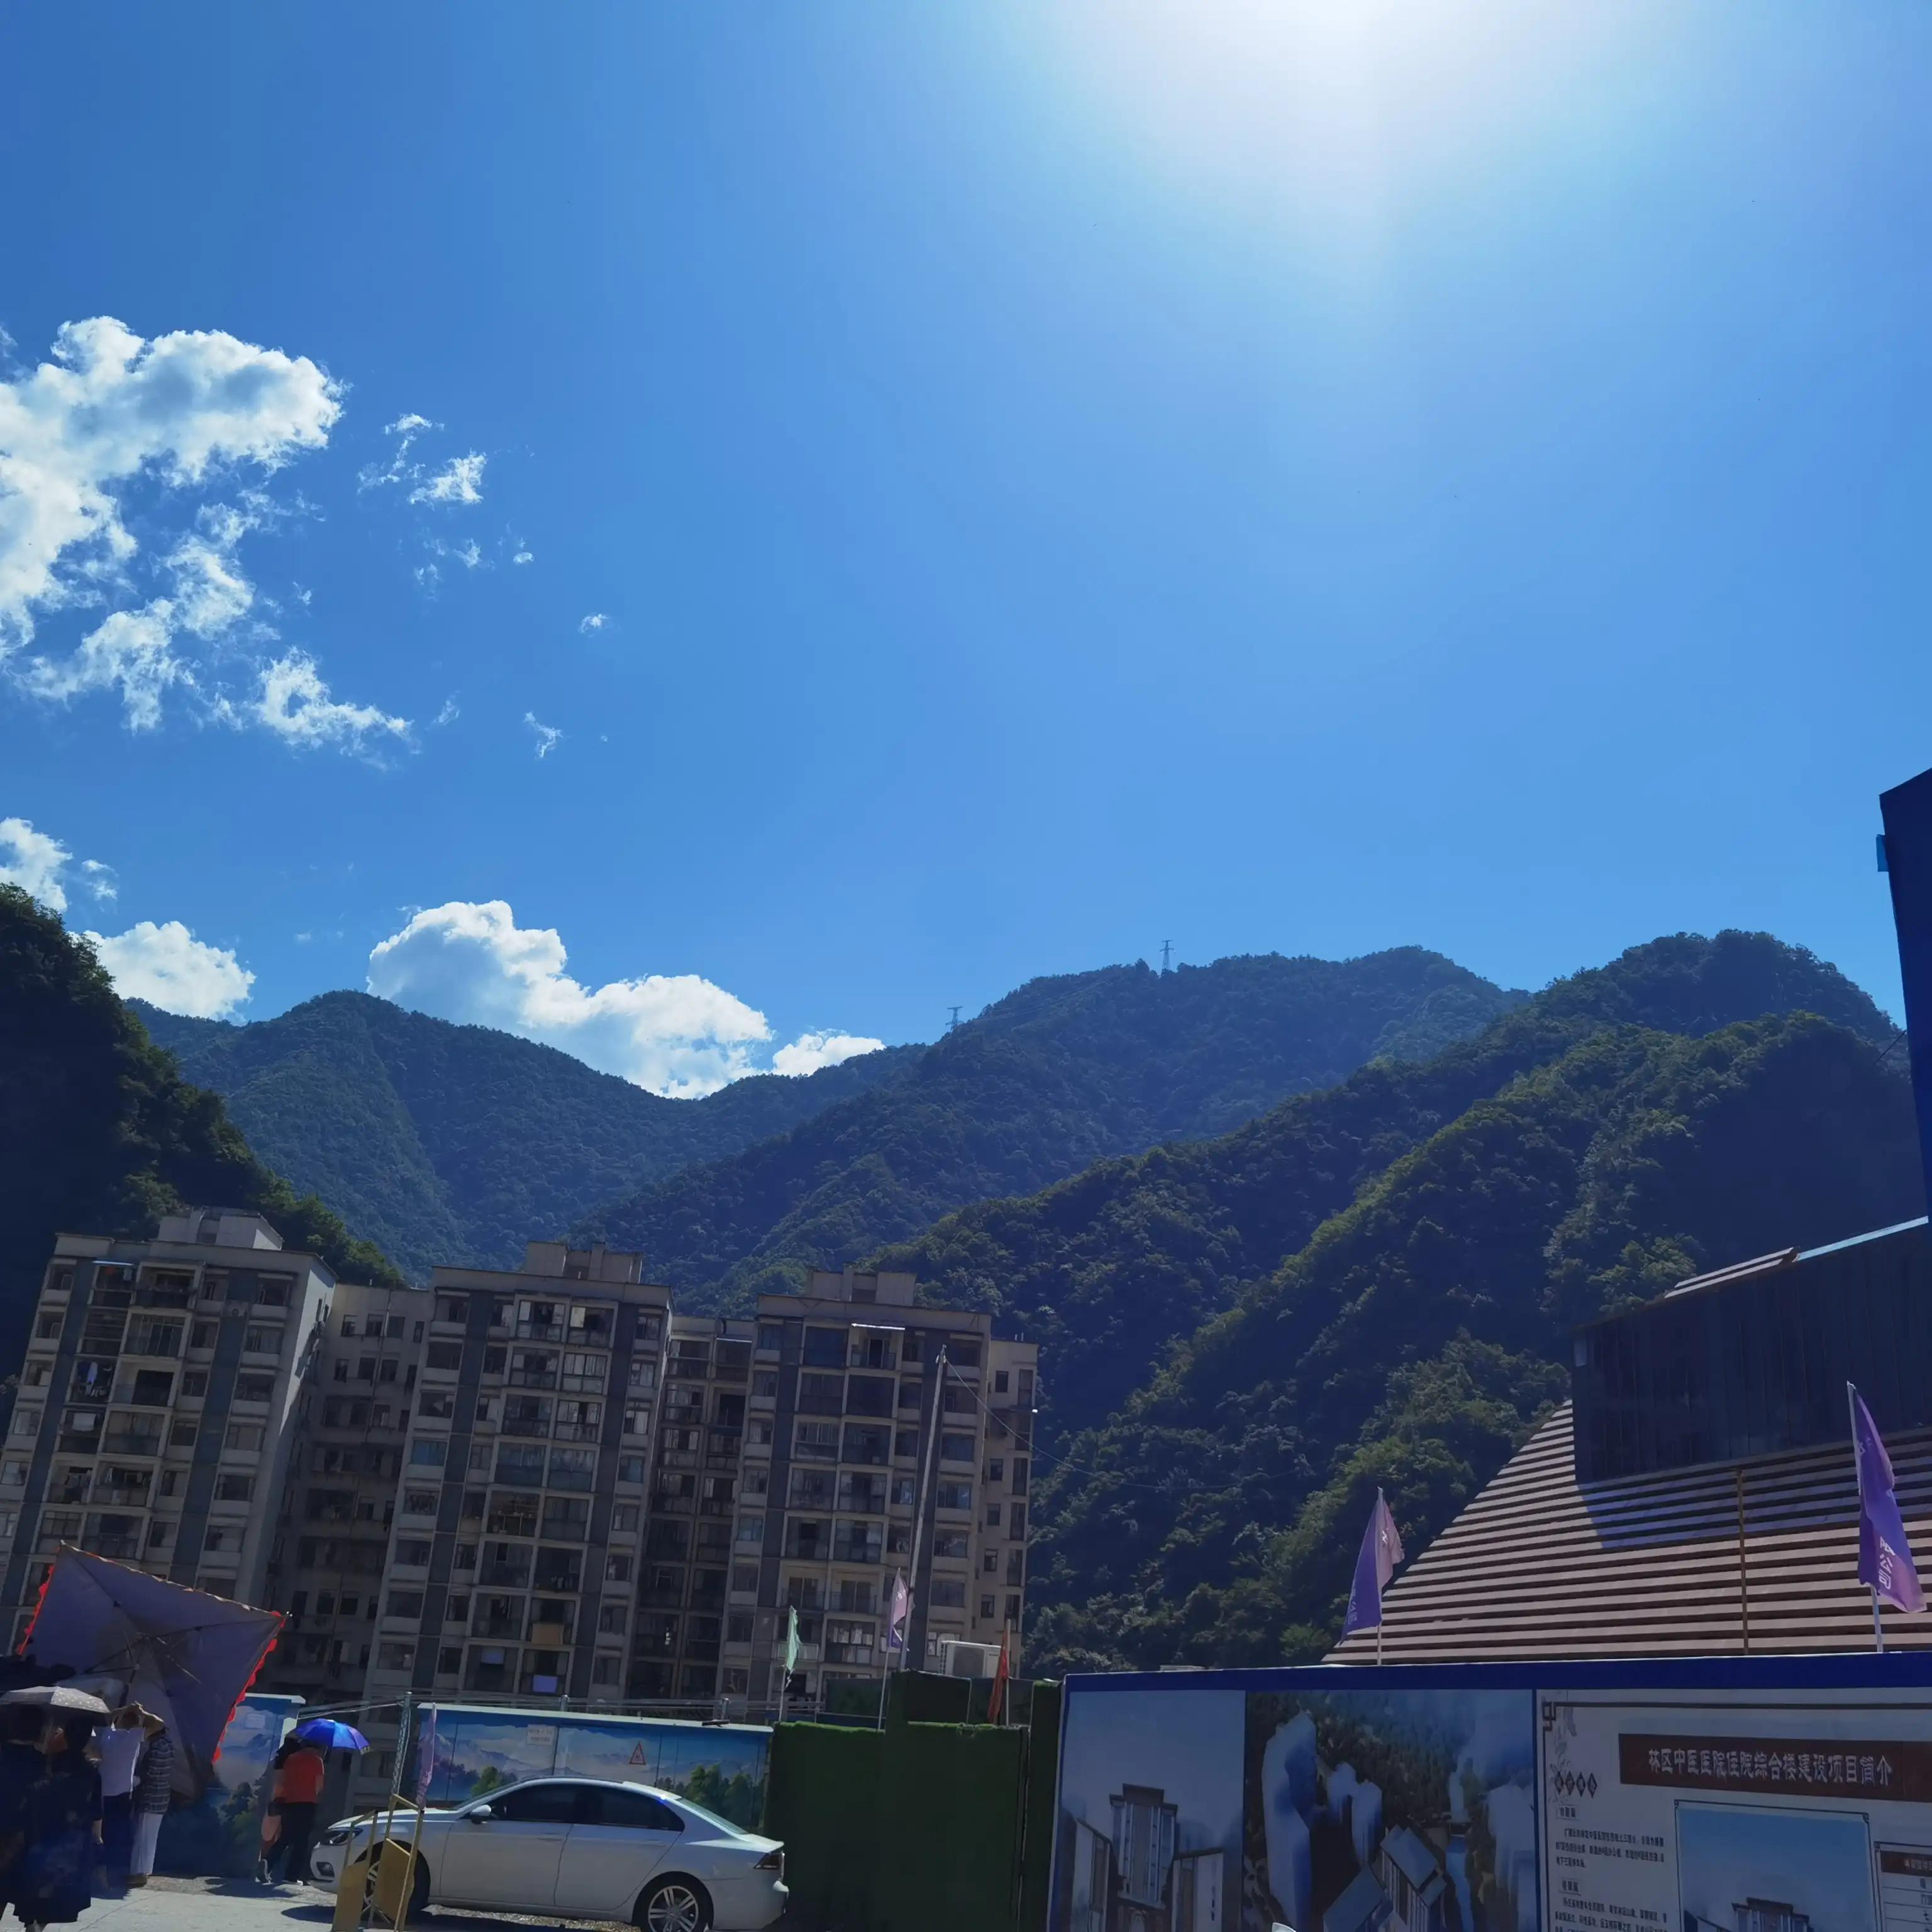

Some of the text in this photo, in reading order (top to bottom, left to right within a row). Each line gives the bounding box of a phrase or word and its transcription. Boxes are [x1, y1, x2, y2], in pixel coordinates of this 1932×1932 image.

[1648, 1748, 1892, 1787] 林区中医医院住院综合楼建设项目简介
